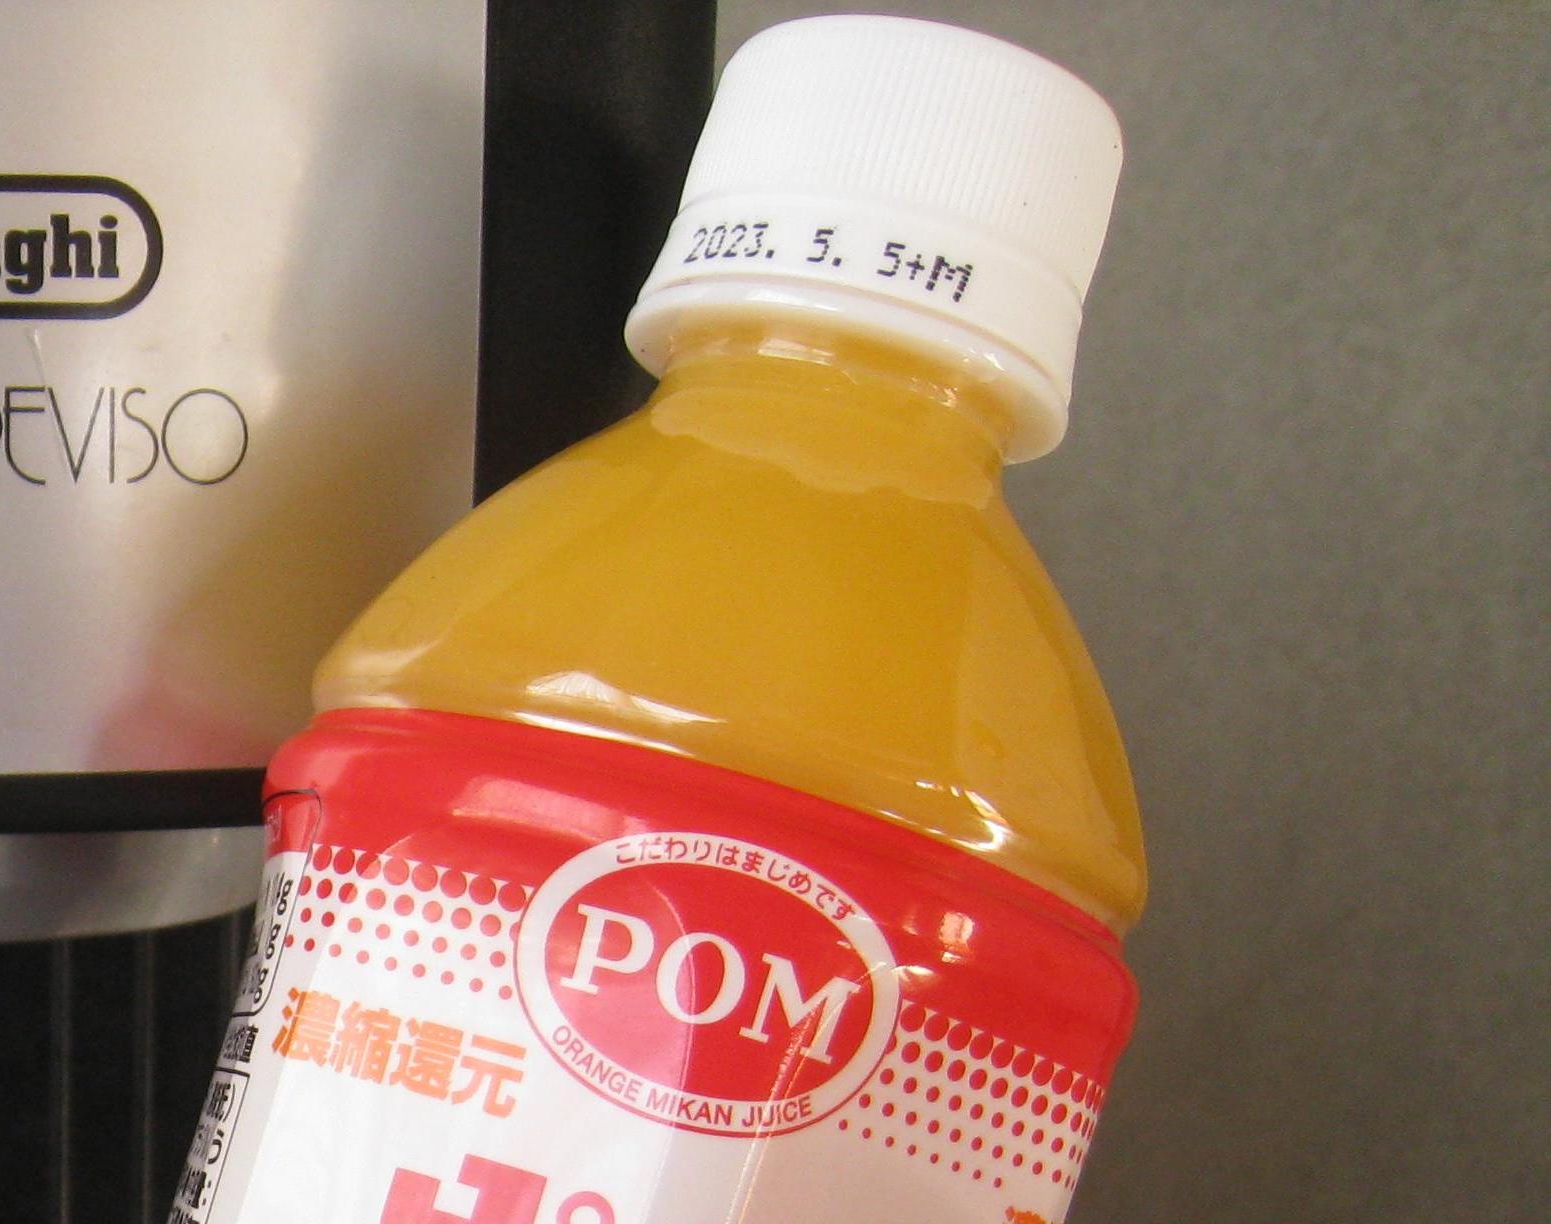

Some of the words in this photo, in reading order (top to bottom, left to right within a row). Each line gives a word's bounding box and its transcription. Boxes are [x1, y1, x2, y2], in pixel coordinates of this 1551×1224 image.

[682, 222, 776, 264] 2023.
[805, 228, 843, 268] 5.
[876, 242, 974, 303] 5+M
[615, 836, 858, 922] こだわりはまじめです
[559, 903, 862, 1066] POM
[271, 988, 528, 1120] 濃縮還元
[551, 1024, 642, 1103] ORANGE
[644, 1088, 734, 1127] MIKAN
[741, 1095, 813, 1128] JUICE
